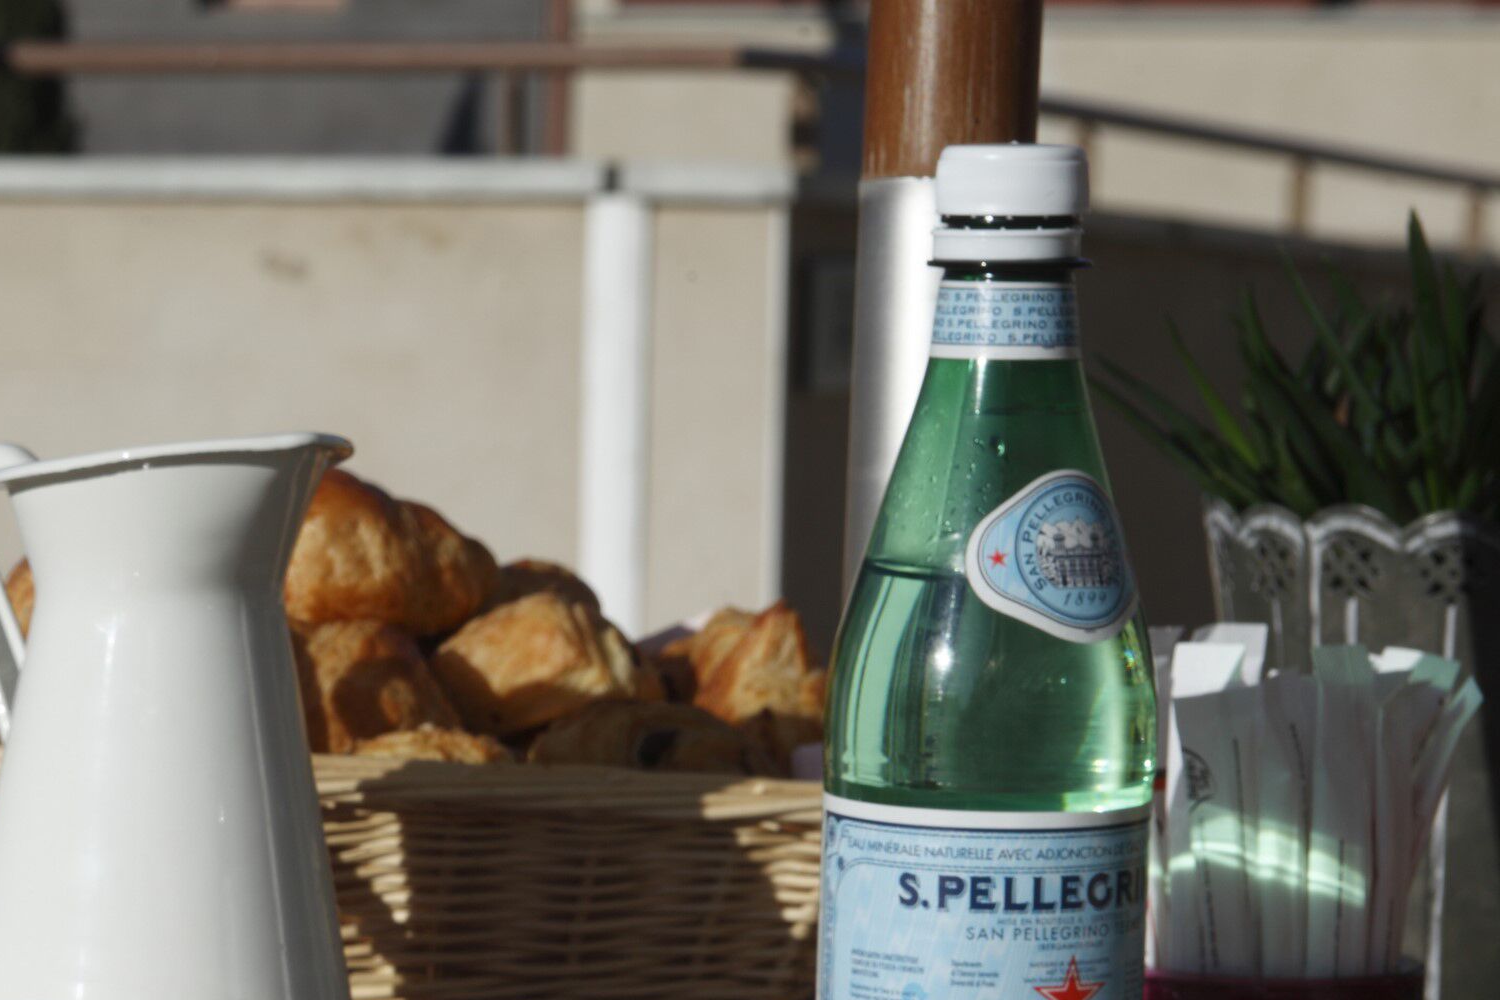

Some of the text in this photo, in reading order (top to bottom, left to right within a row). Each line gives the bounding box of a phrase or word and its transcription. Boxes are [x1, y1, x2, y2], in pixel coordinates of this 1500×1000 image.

[1023, 553, 1048, 591] SAN
[1063, 592, 1107, 606] 1899
[924, 846, 993, 861] NATURELLE
[997, 848, 1032, 861] AVEC
[966, 926, 1004, 941] SAN
[1013, 923, 1109, 941] PELLEGRINO
